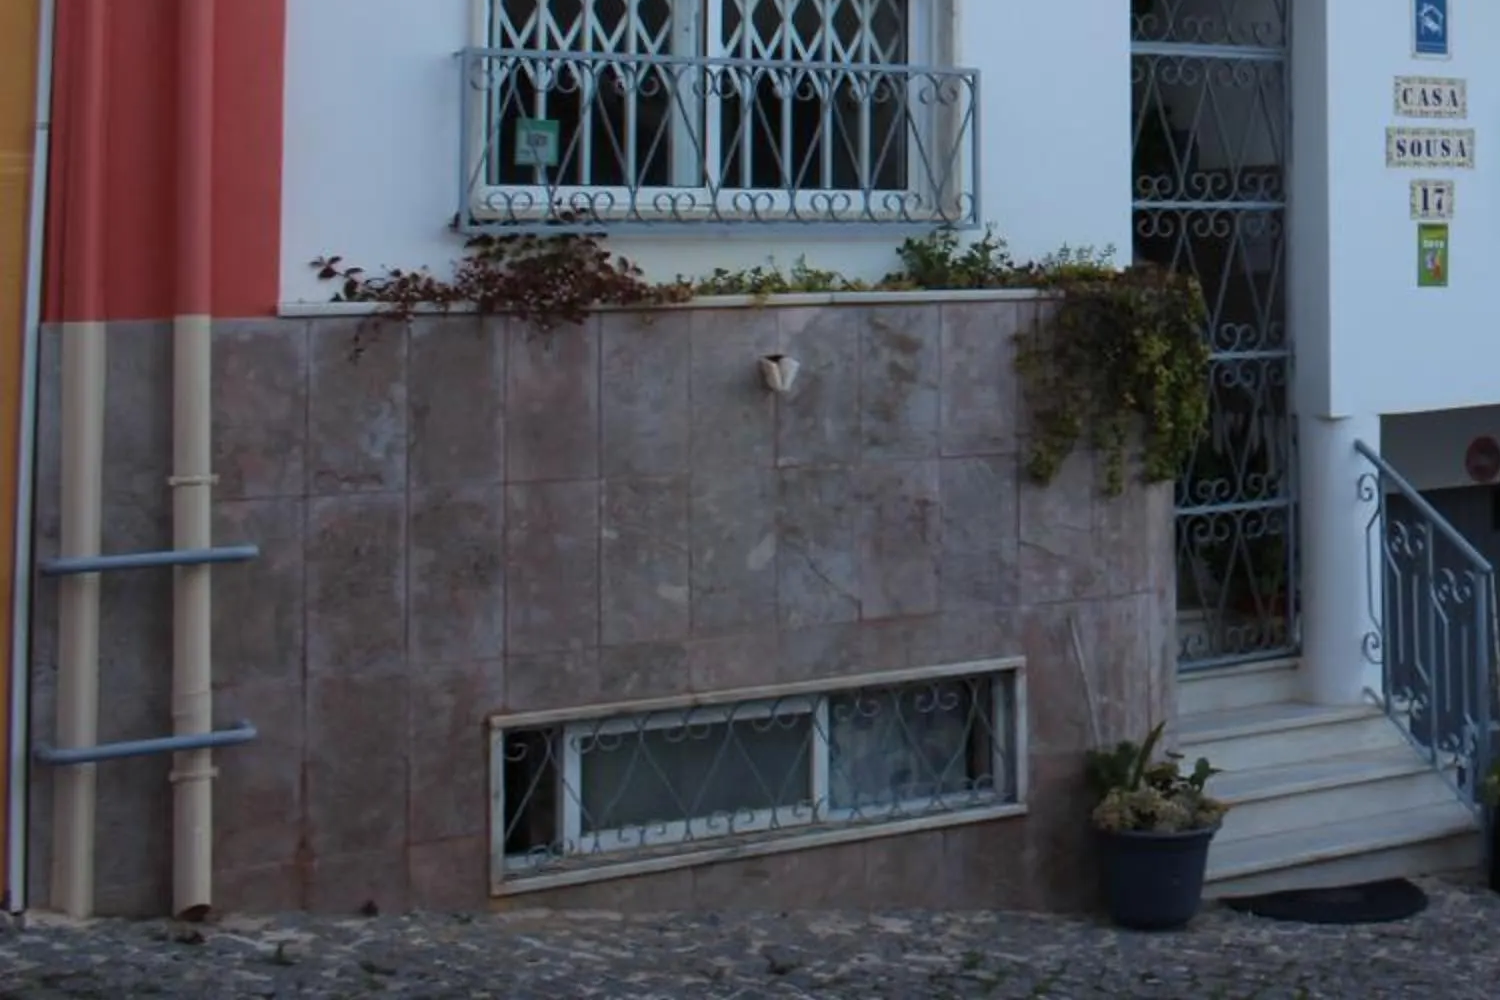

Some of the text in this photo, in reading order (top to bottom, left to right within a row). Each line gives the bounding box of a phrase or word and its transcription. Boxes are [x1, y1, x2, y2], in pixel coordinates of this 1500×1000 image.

[1402, 87, 1458, 107] CASA
[1396, 138, 1466, 158] SOUSA
[1421, 187, 1445, 211] 17
